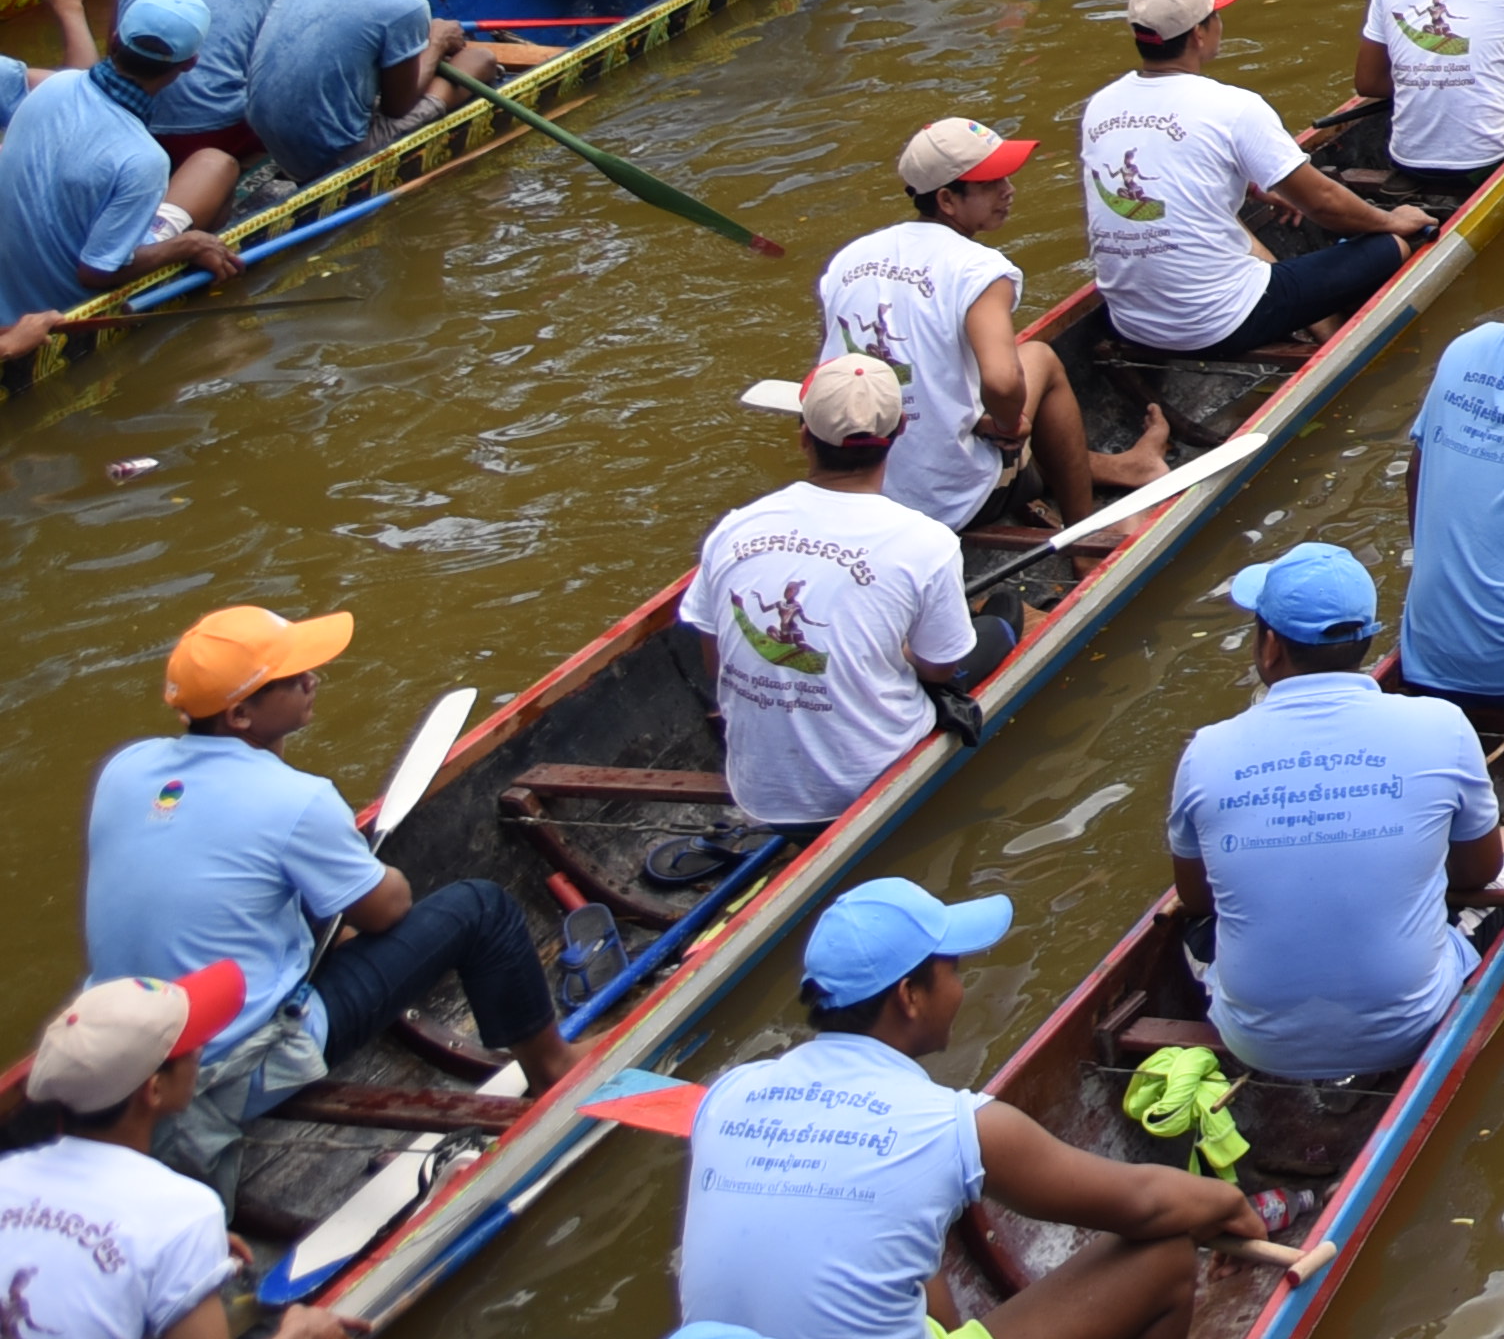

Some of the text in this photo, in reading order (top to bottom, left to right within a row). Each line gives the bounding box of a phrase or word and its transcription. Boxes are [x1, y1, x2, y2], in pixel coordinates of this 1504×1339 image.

[1240, 834, 1297, 849] University
[1299, 832, 1313, 844] of
[1315, 828, 1376, 844] South-East
[1379, 823, 1405, 837] Asia
[716, 1175, 766, 1194] University
[768, 1181, 779, 1195] of
[780, 1181, 845, 1198] South-East
[848, 1188, 876, 1201] Asia
